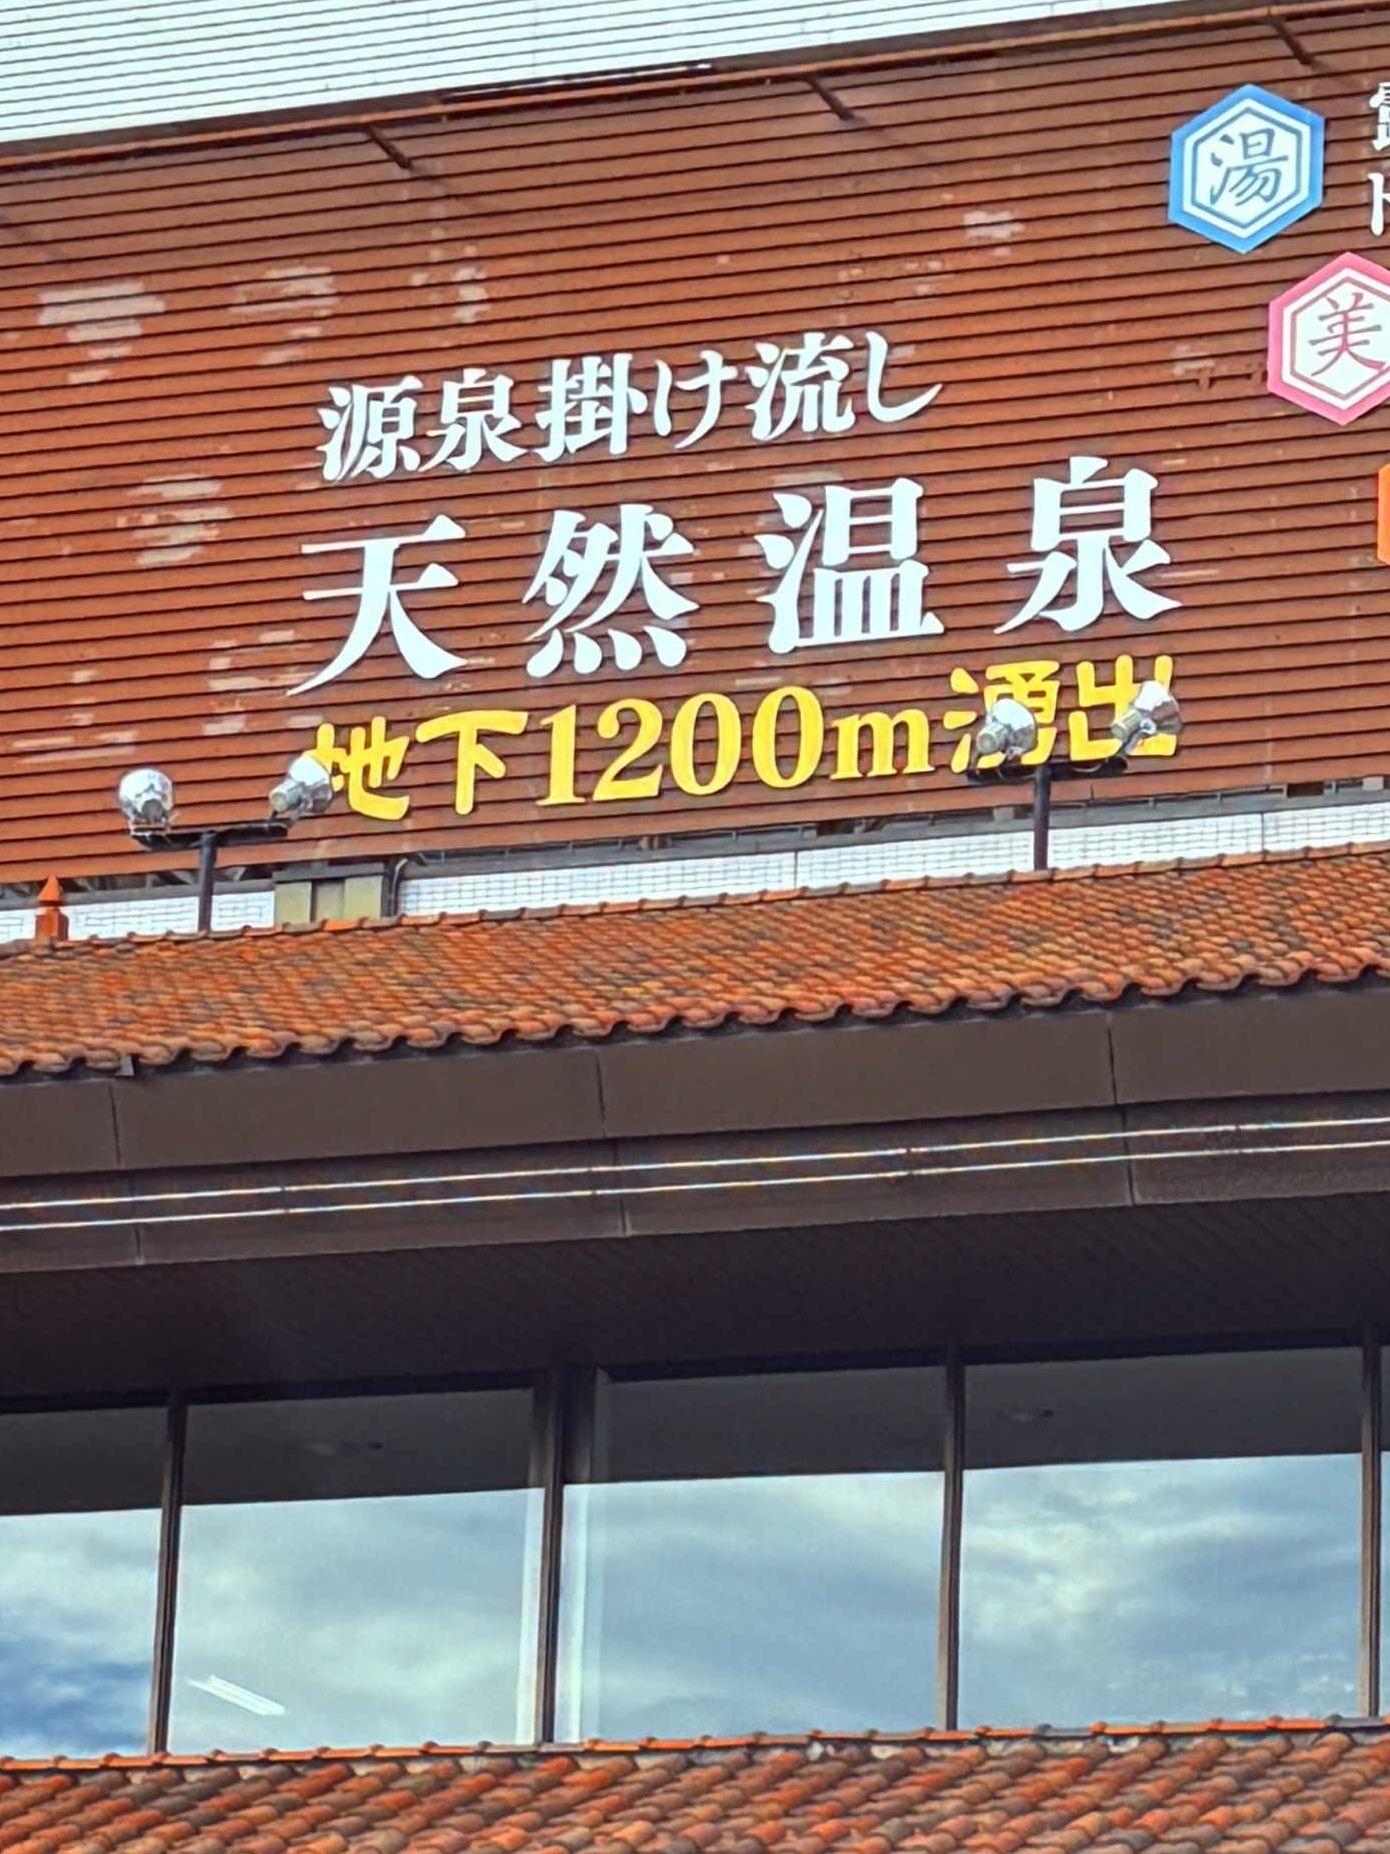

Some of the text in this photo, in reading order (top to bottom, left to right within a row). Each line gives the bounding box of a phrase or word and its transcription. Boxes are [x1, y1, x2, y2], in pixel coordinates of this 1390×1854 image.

[1209, 127, 1290, 206] 湯
[317, 330, 943, 483] 源泉掛け流し
[1306, 291, 1387, 379] 美
[287, 455, 1183, 695] 天然温泉
[307, 654, 1180, 820] 地下1200m湧出
